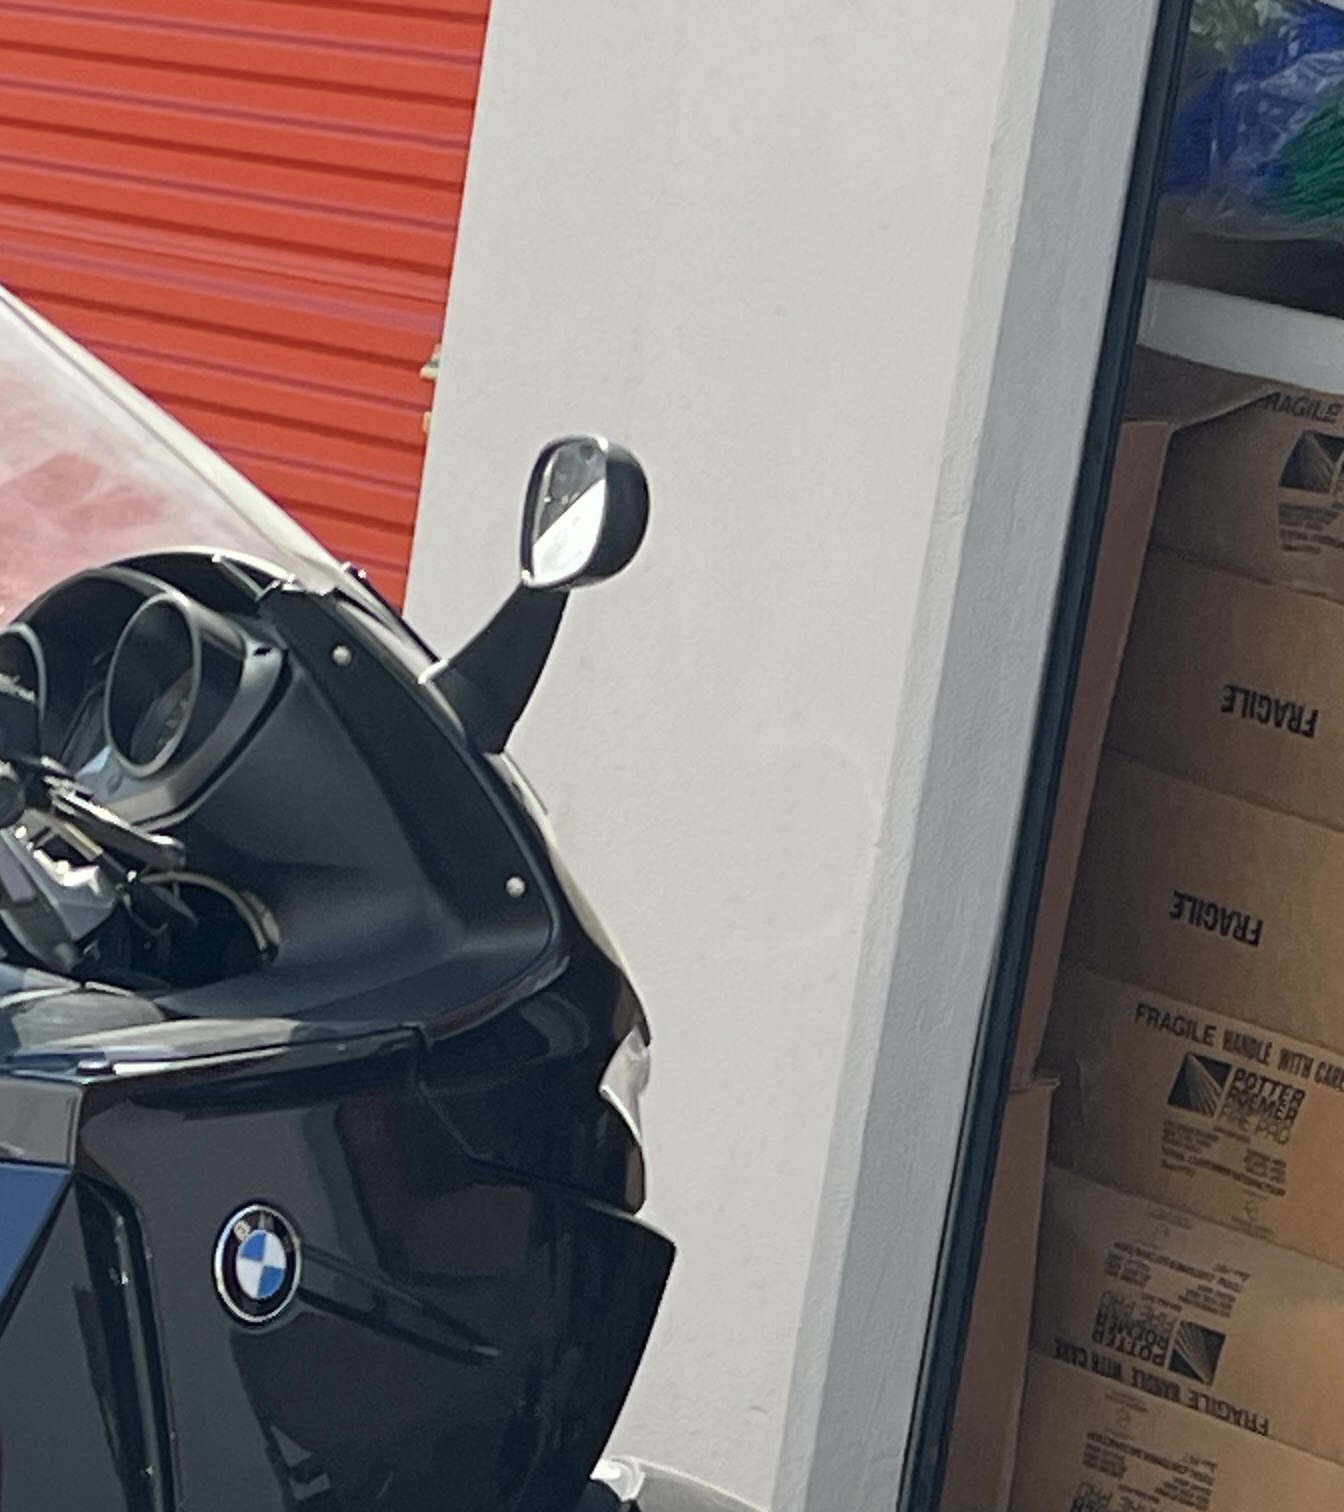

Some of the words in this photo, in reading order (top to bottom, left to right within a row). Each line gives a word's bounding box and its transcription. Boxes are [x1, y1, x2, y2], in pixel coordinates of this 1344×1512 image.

[1221, 684, 1318, 739] FRAGILE
[1170, 890, 1264, 946] FRAGILE
[1134, 1003, 1216, 1046] FRAGILE
[1234, 1068, 1306, 1103] POTTER
[1187, 1390, 1269, 1436] FRAGILE
